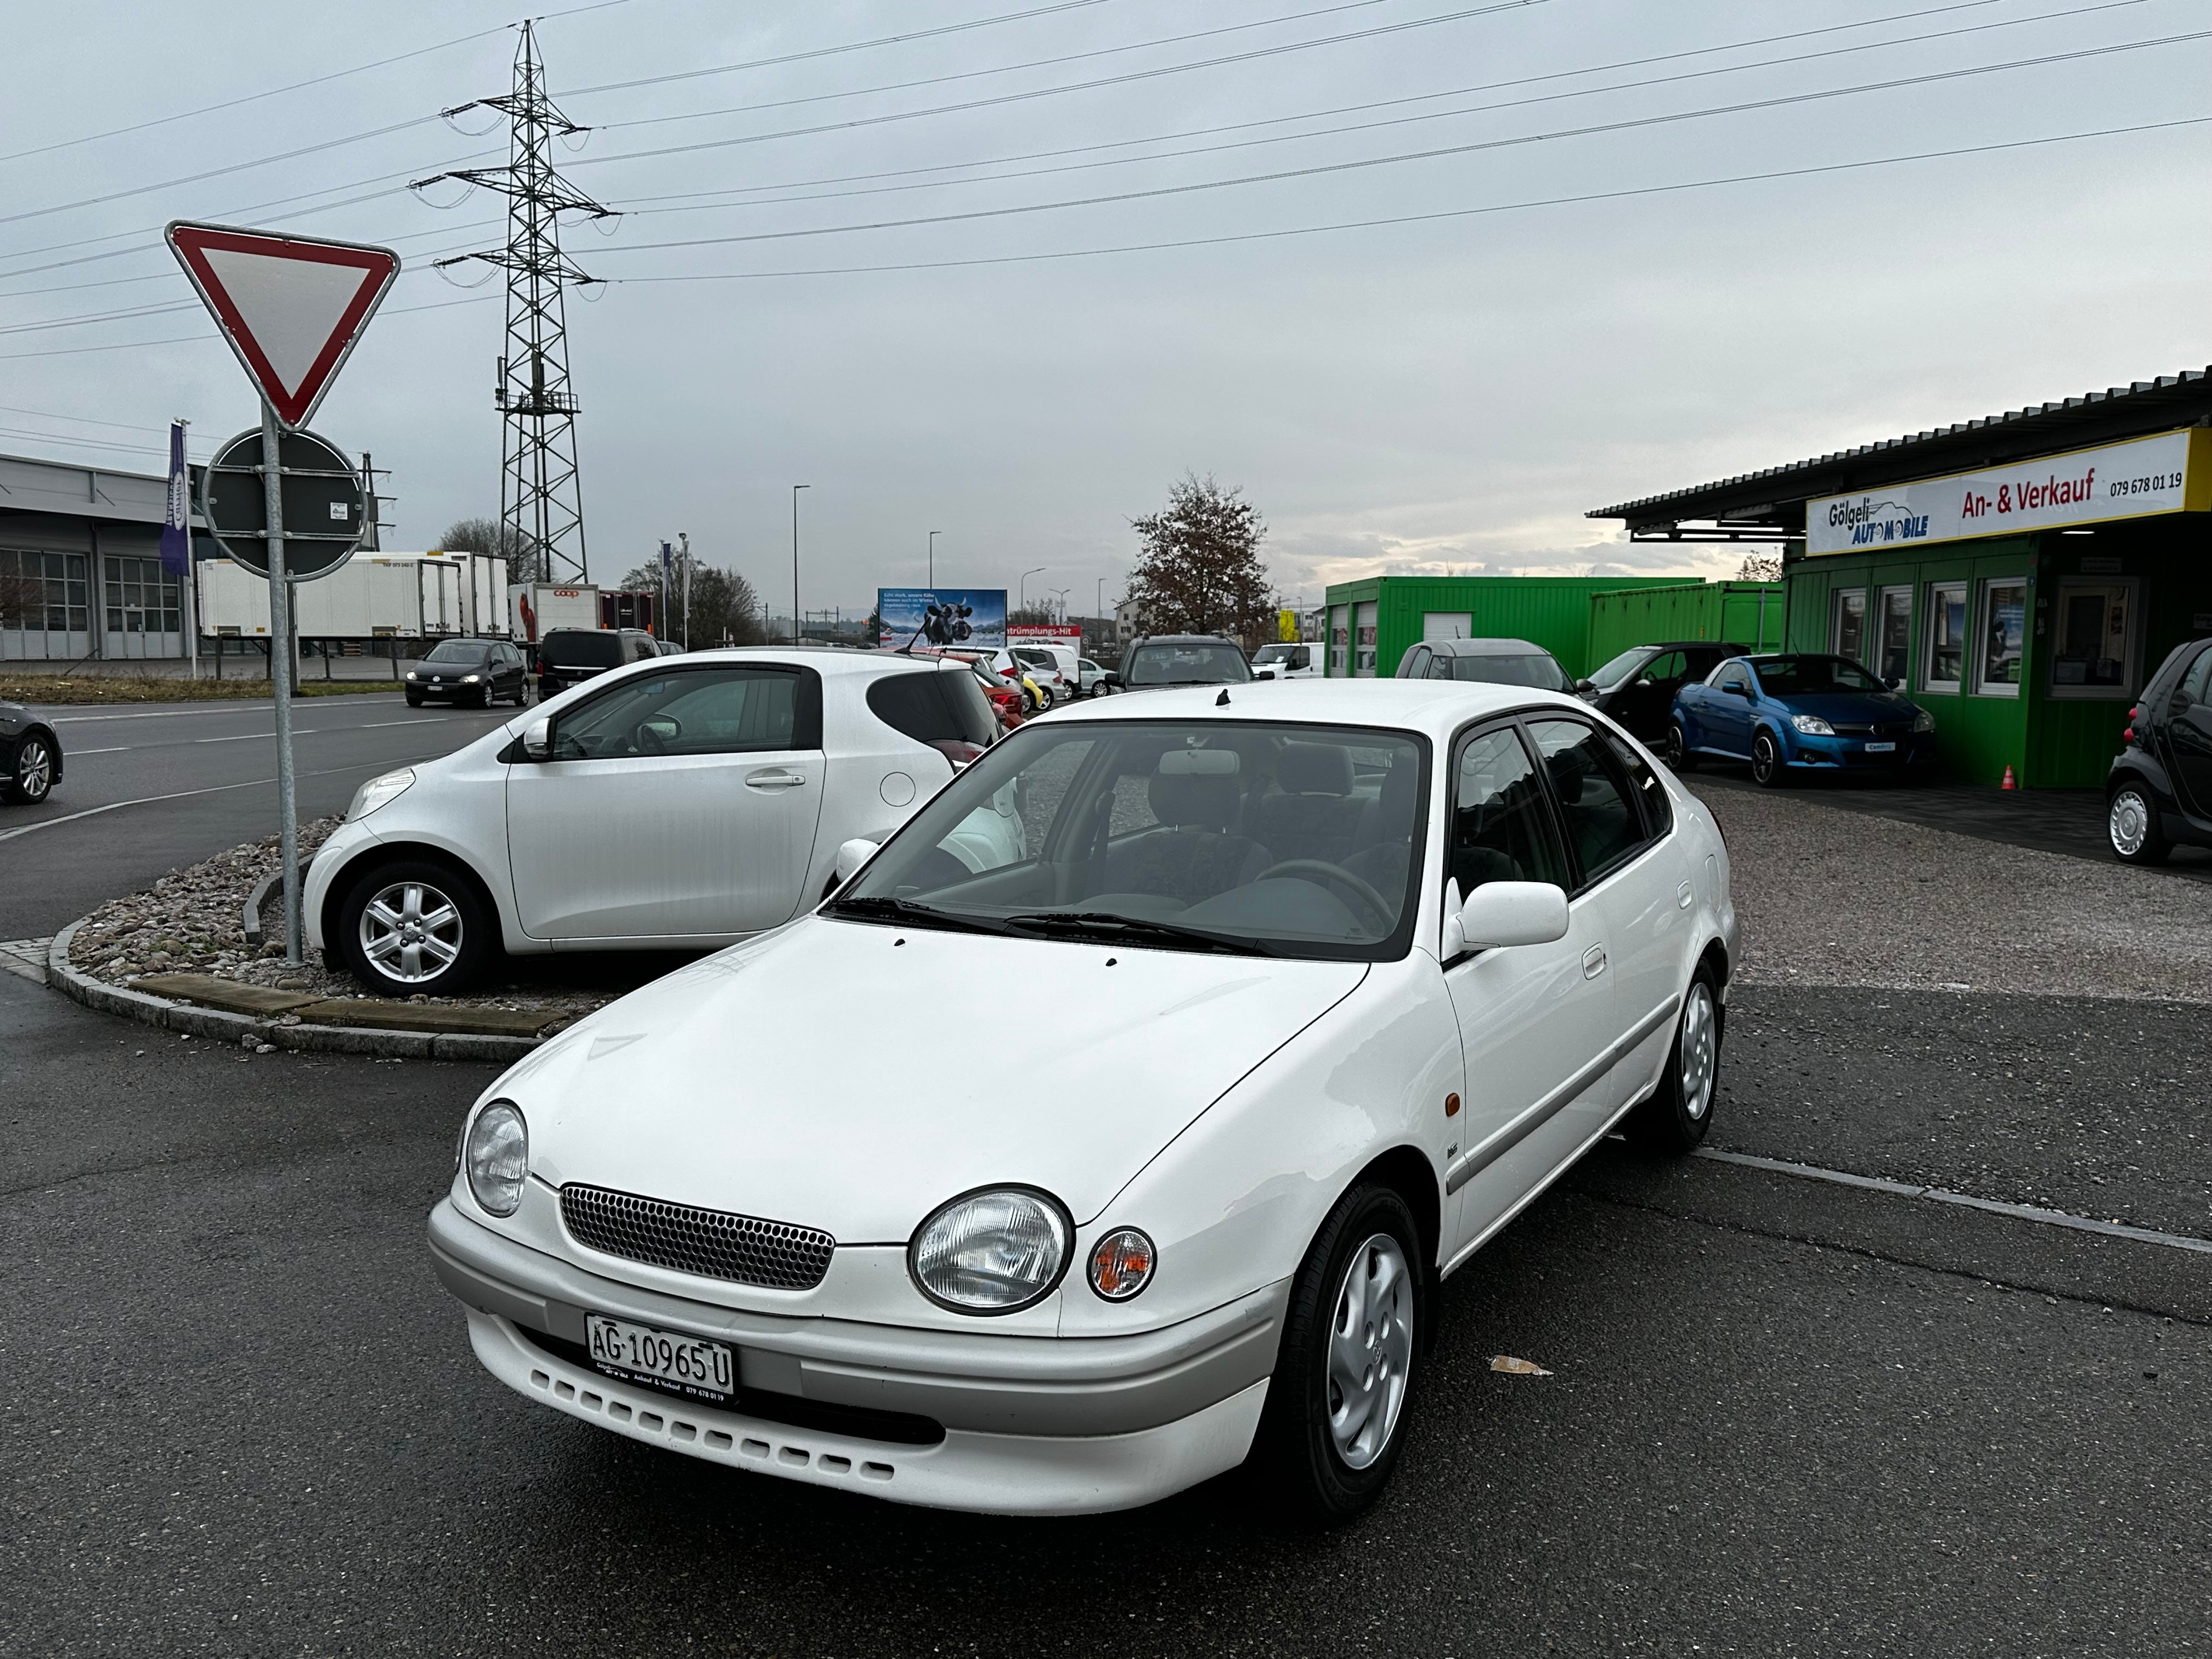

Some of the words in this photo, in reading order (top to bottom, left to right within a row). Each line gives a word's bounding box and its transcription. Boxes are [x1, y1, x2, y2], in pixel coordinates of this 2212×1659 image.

[1962, 492, 1992, 518] An-
[1997, 484, 2011, 514] &
[2017, 468, 2095, 510] Verkauf
[2111, 481, 2128, 496] 079
[2131, 477, 2149, 494] 678
[2153, 475, 2165, 490] 01
[2169, 472, 2182, 488] 19
[1830, 497, 1869, 531] Gölgeli
[1852, 515, 1928, 544] AUTOMOBILE
[554, 590, 579, 599] coop
[698, 1390, 709, 1398] 678
